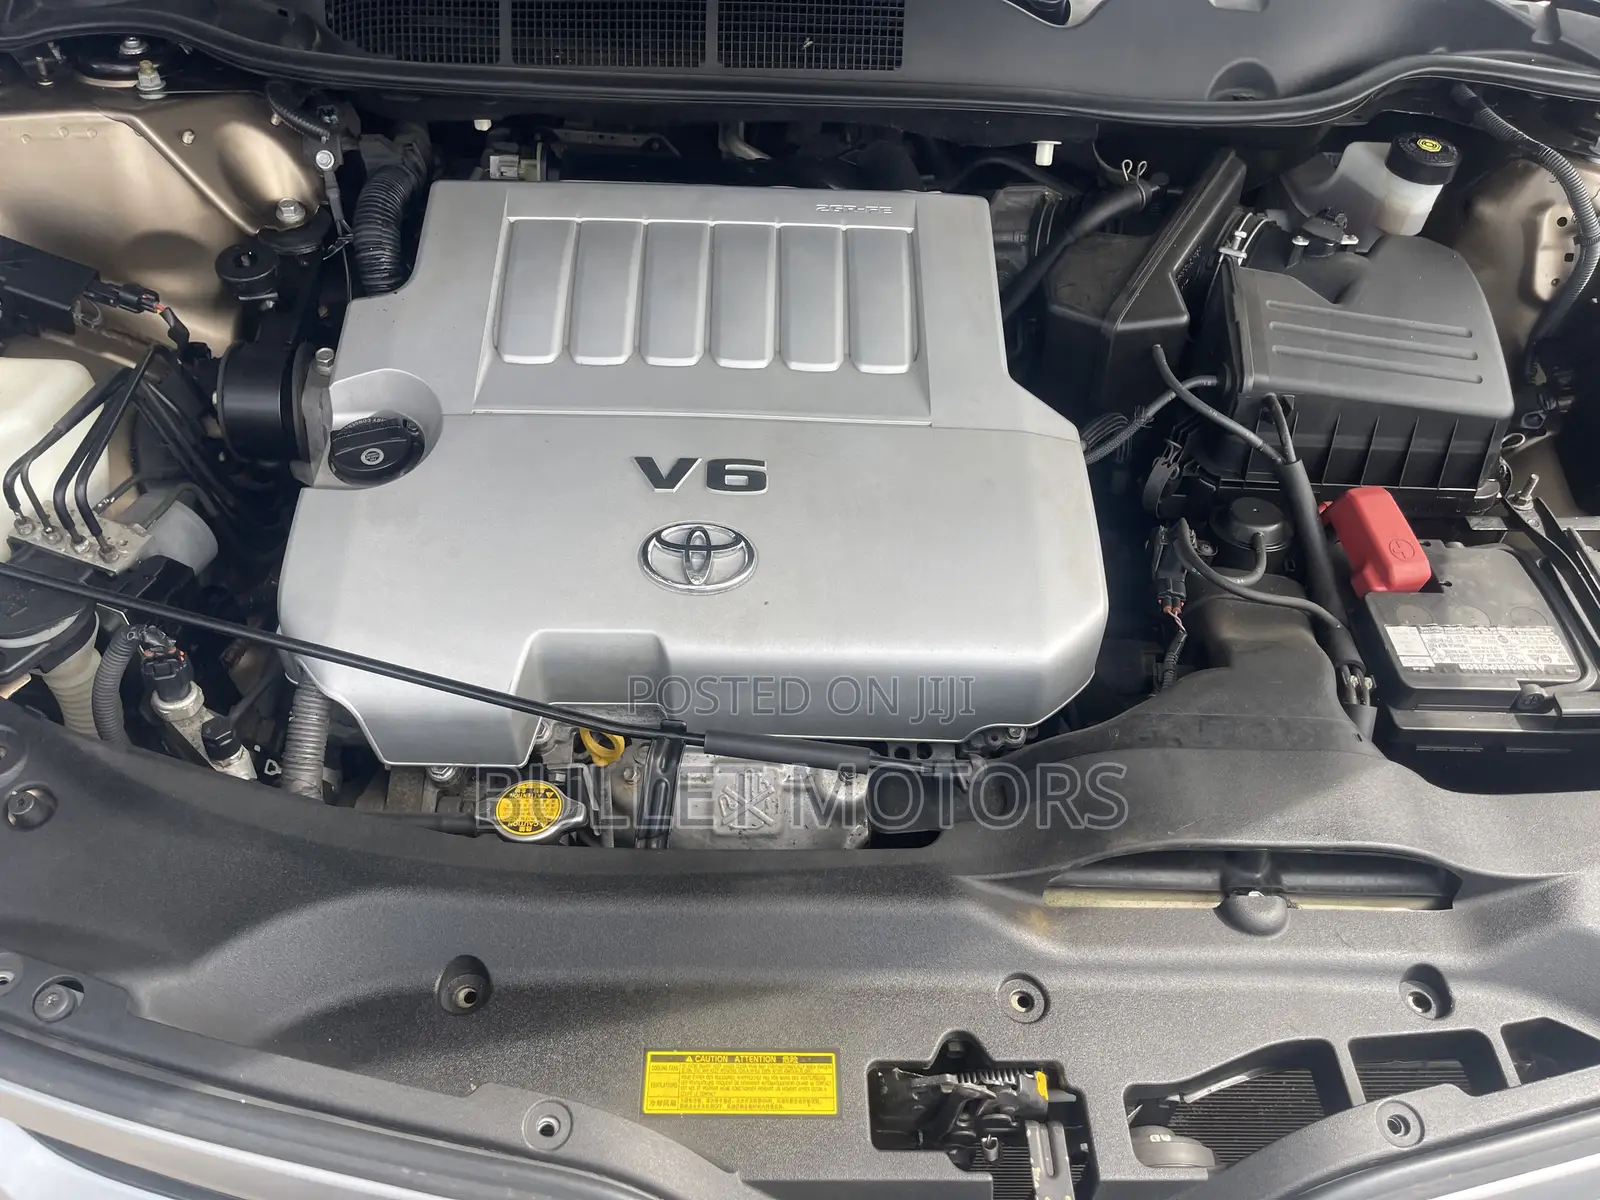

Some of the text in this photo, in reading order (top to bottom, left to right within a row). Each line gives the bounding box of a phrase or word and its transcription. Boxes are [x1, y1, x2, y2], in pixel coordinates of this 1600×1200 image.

[630, 456, 768, 495] V6
[694, 1055, 728, 1063] CAUTION
[734, 1055, 776, 1064] ATTENTION
